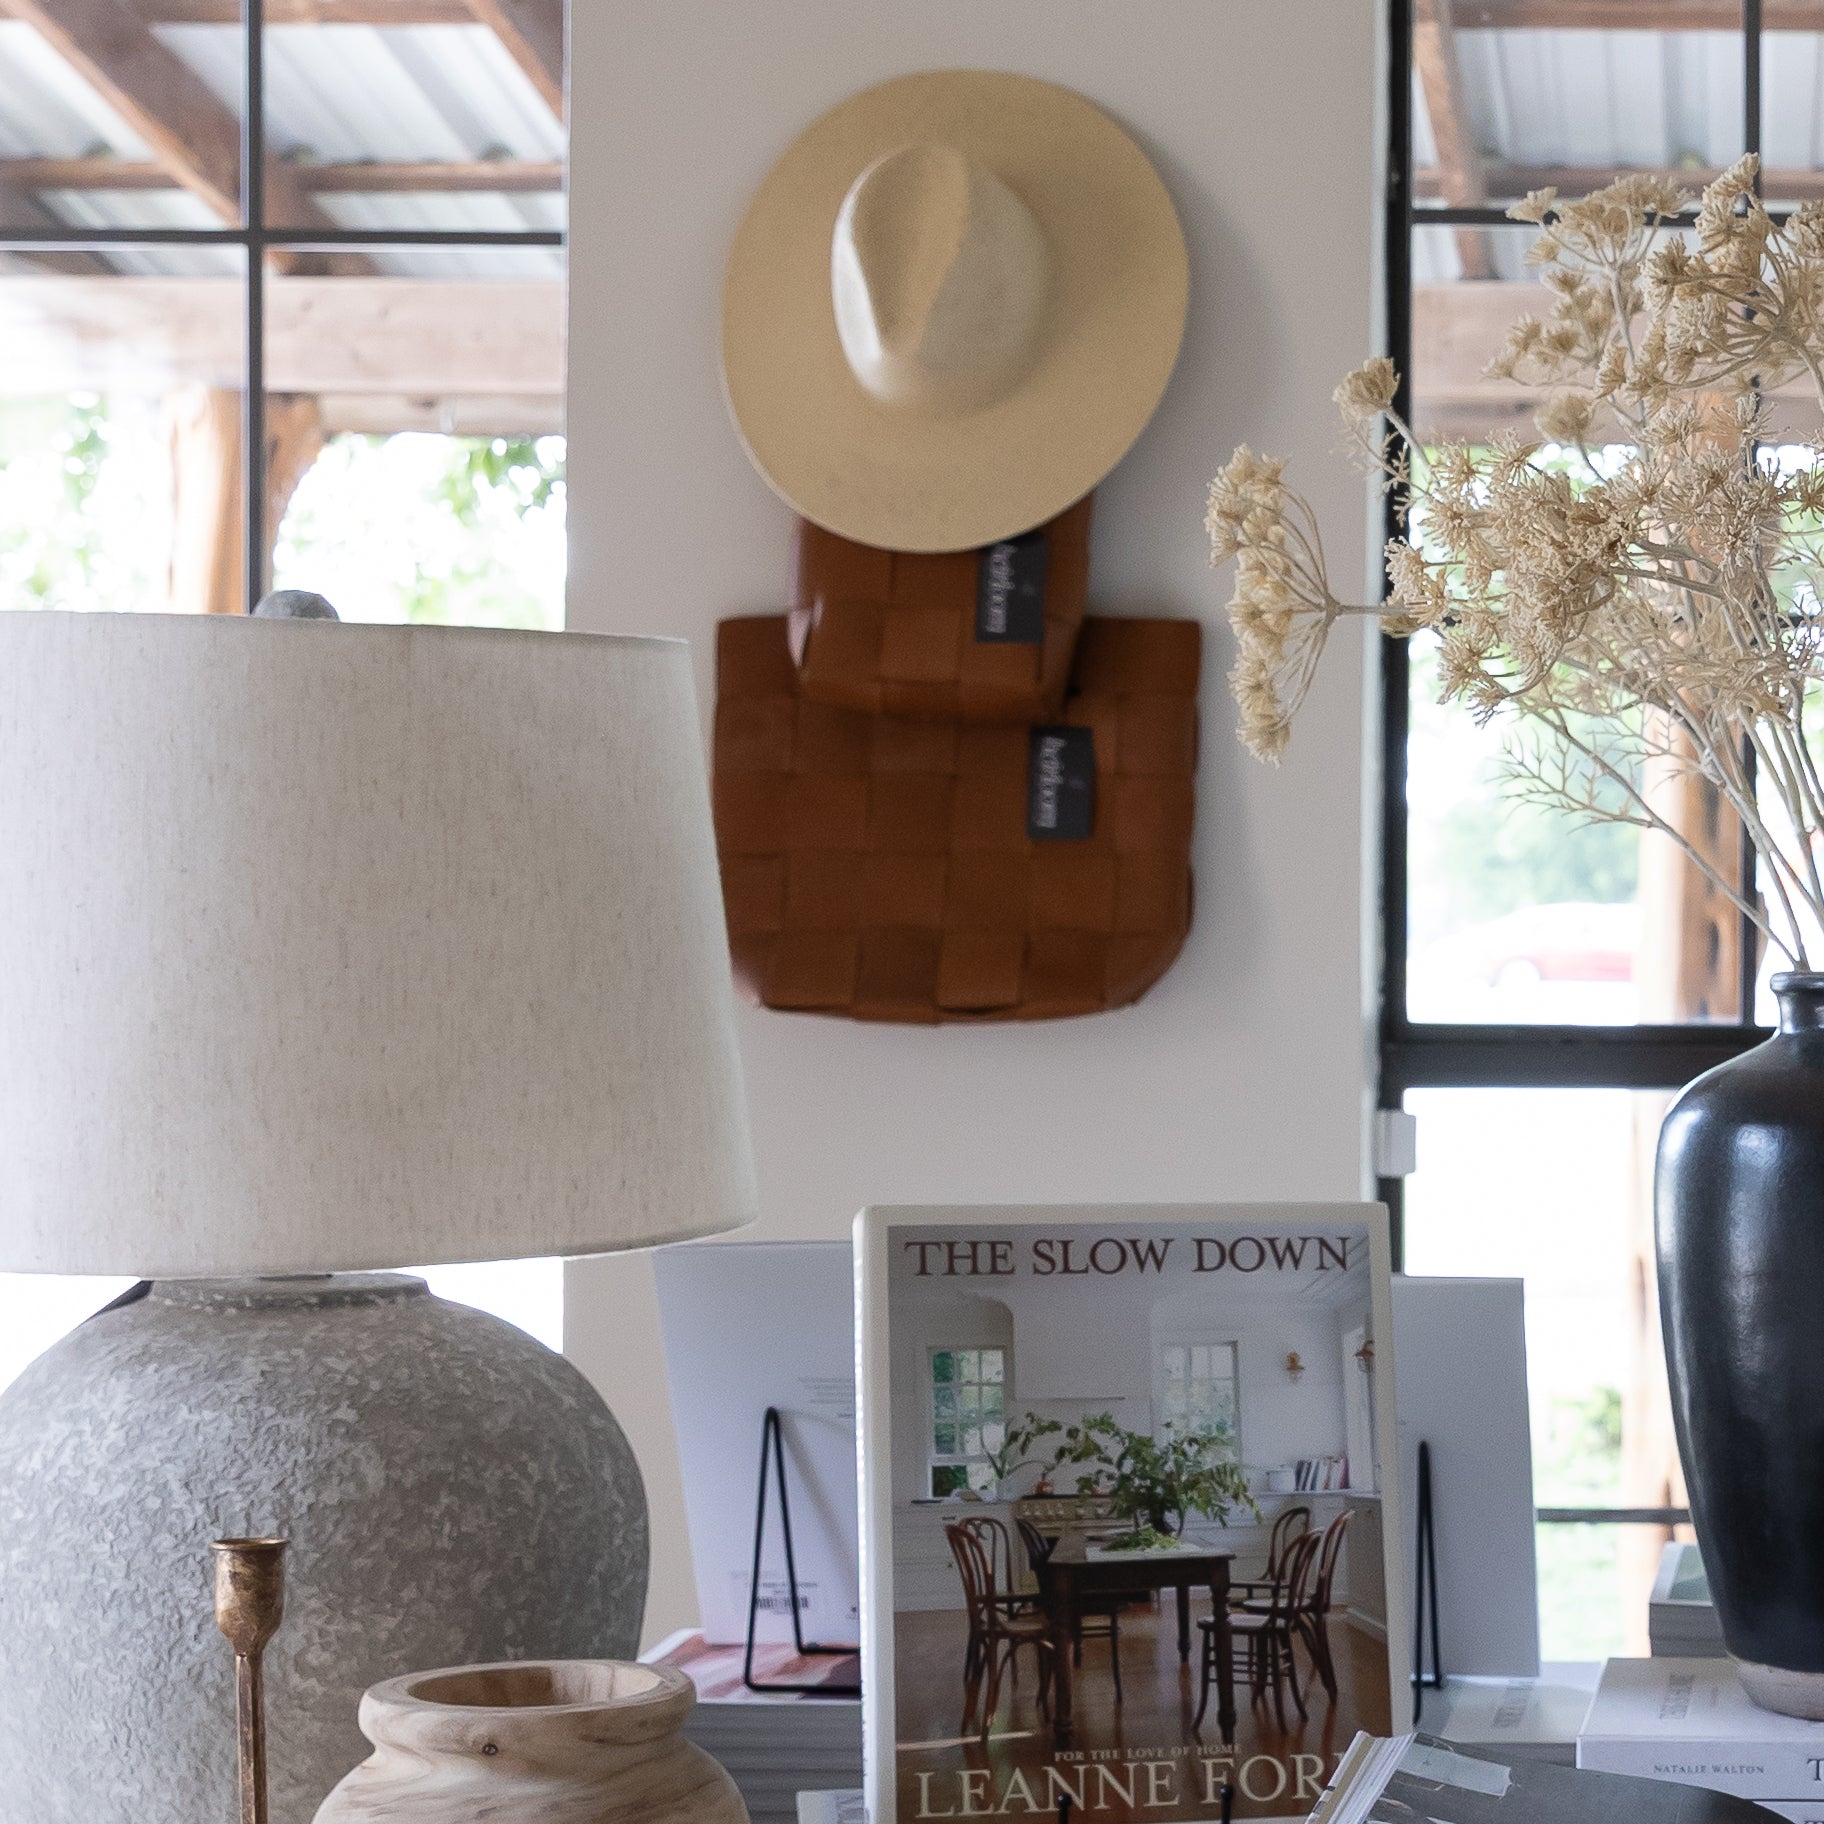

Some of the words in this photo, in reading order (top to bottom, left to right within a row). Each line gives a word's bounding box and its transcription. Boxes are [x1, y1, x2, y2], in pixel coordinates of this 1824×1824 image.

[904, 1238, 1017, 1277] THE
[1033, 1236, 1175, 1275] SLOW
[1192, 1234, 1352, 1273] DOWN
[1054, 1750, 1085, 1763] FOR
[1091, 1749, 1120, 1761] THE
[1126, 1747, 1167, 1760] LOVE
[1170, 1745, 1190, 1758] OF
[1195, 1743, 1243, 1756] HOME
[1653, 1764, 1706, 1775] NATALIE
[1711, 1764, 1765, 1775] WALTON
[915, 1760, 1181, 1819] LEANNE
[1200, 1753, 1342, 1806] FOR
